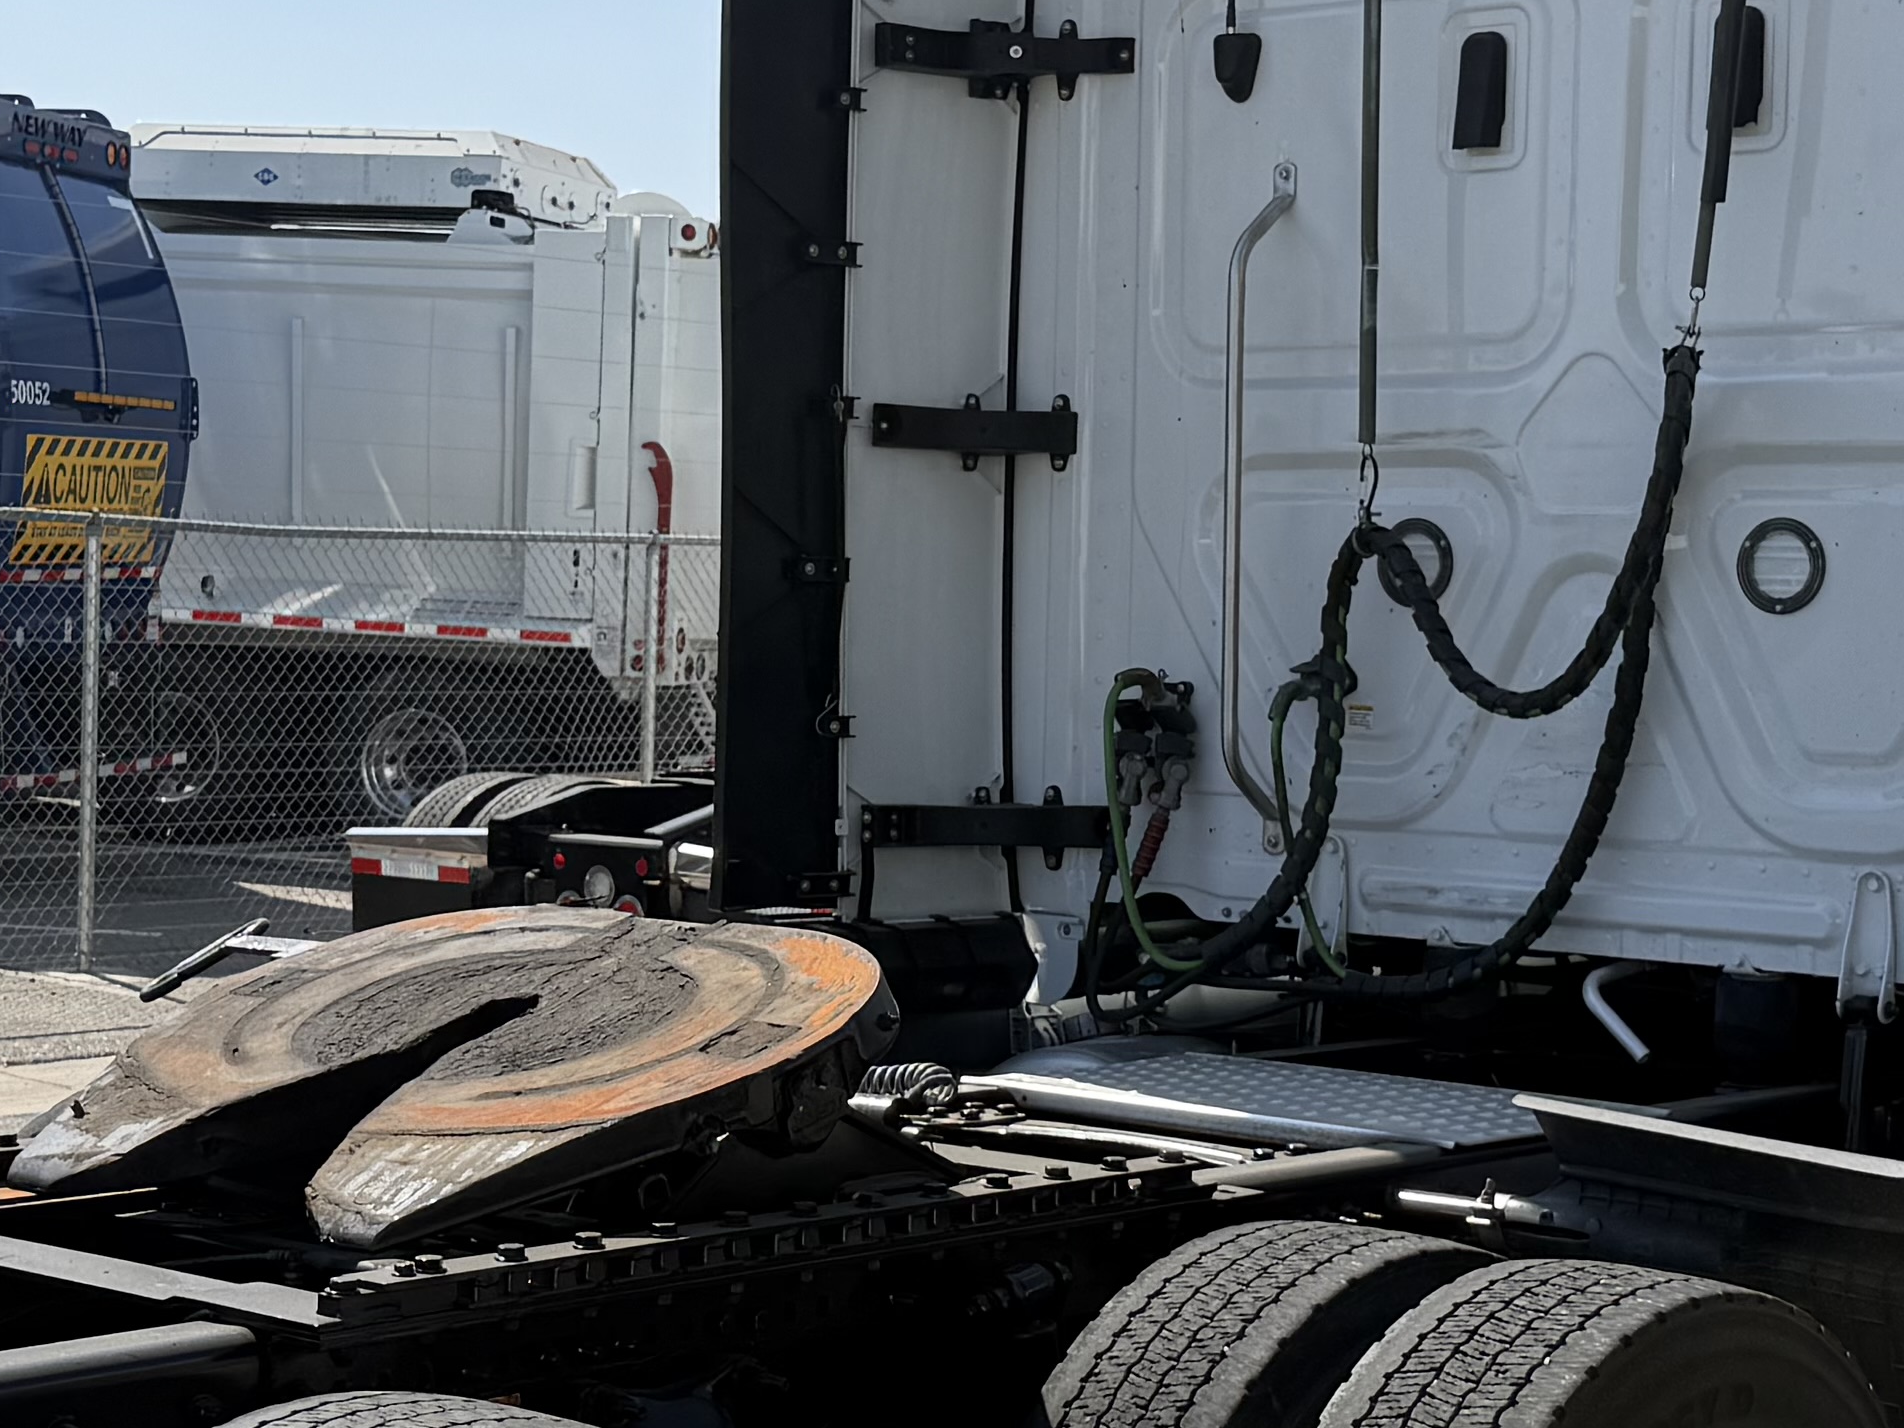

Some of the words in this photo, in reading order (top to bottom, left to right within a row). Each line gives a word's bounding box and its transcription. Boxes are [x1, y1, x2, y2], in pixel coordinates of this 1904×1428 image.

[12, 112, 52, 138] NEW
[53, 121, 87, 147] WAY
[10, 379, 51, 406] 50052
[52, 462, 133, 506] CAUTION
